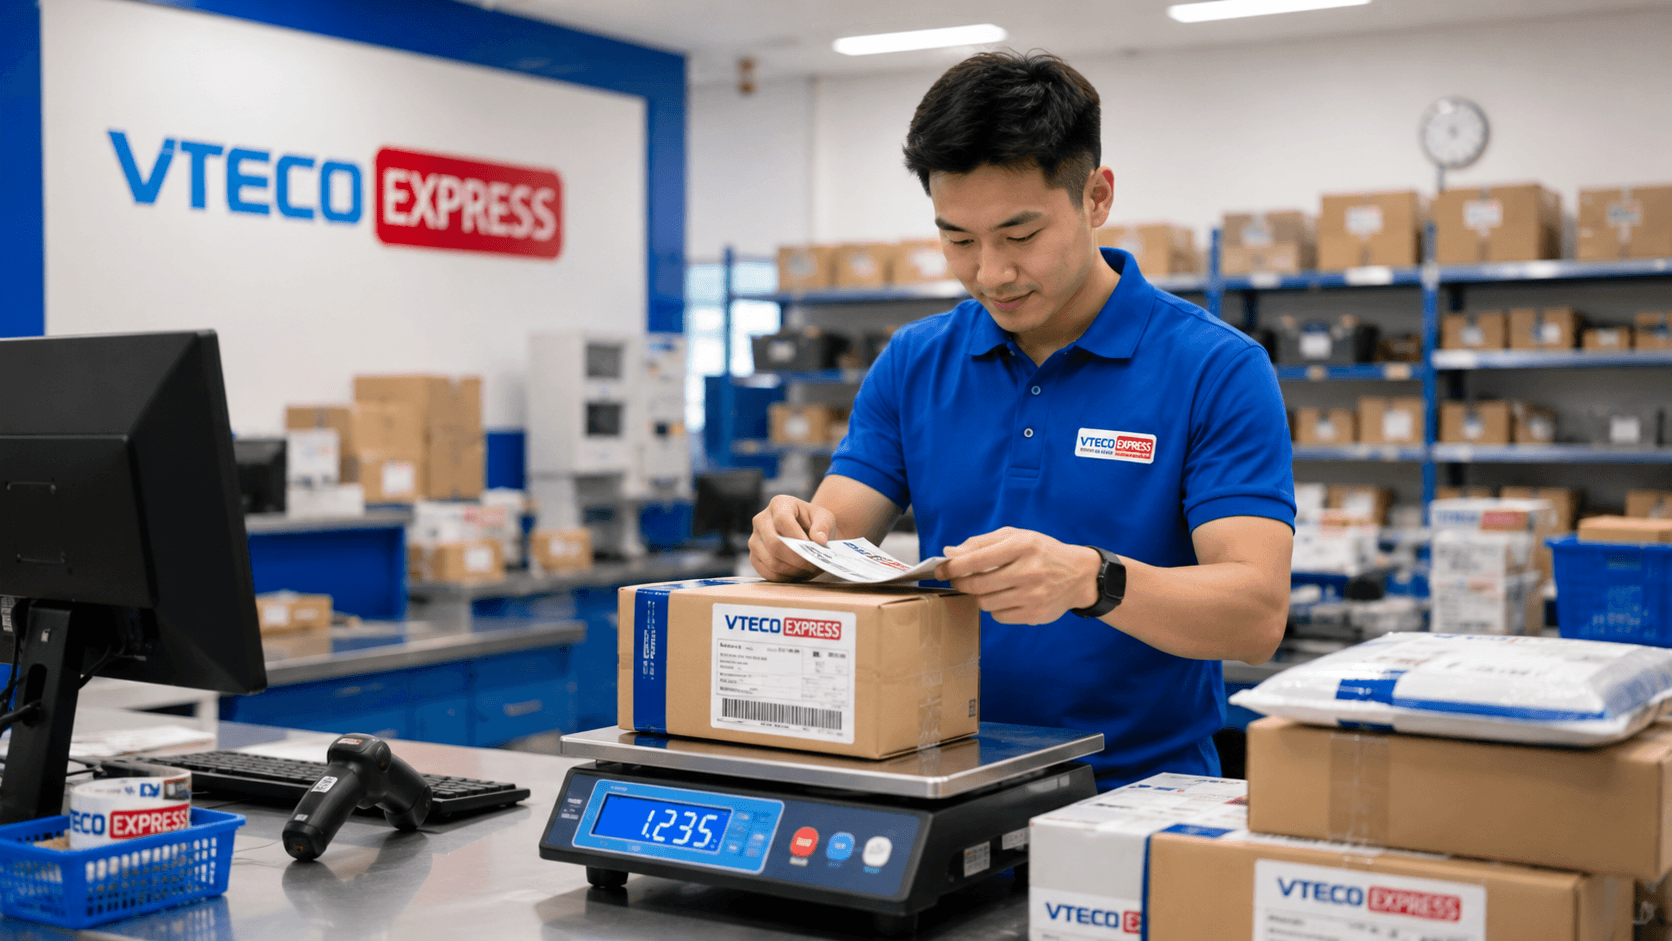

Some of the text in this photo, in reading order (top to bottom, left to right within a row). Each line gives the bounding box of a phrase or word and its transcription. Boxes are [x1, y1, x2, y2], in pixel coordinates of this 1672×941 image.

[107, 128, 556, 241] VTECO EXPRESS
[1080, 436, 1115, 449] VTECO
[1116, 439, 1152, 452] EXPRESS
[724, 614, 840, 638] VTECO EXPRESS
[69, 808, 187, 836] ECO EXPRESS
[641, 809, 718, 848] 1.235
[1278, 876, 1364, 907] VTECO
[1045, 901, 1120, 929] VTECO
